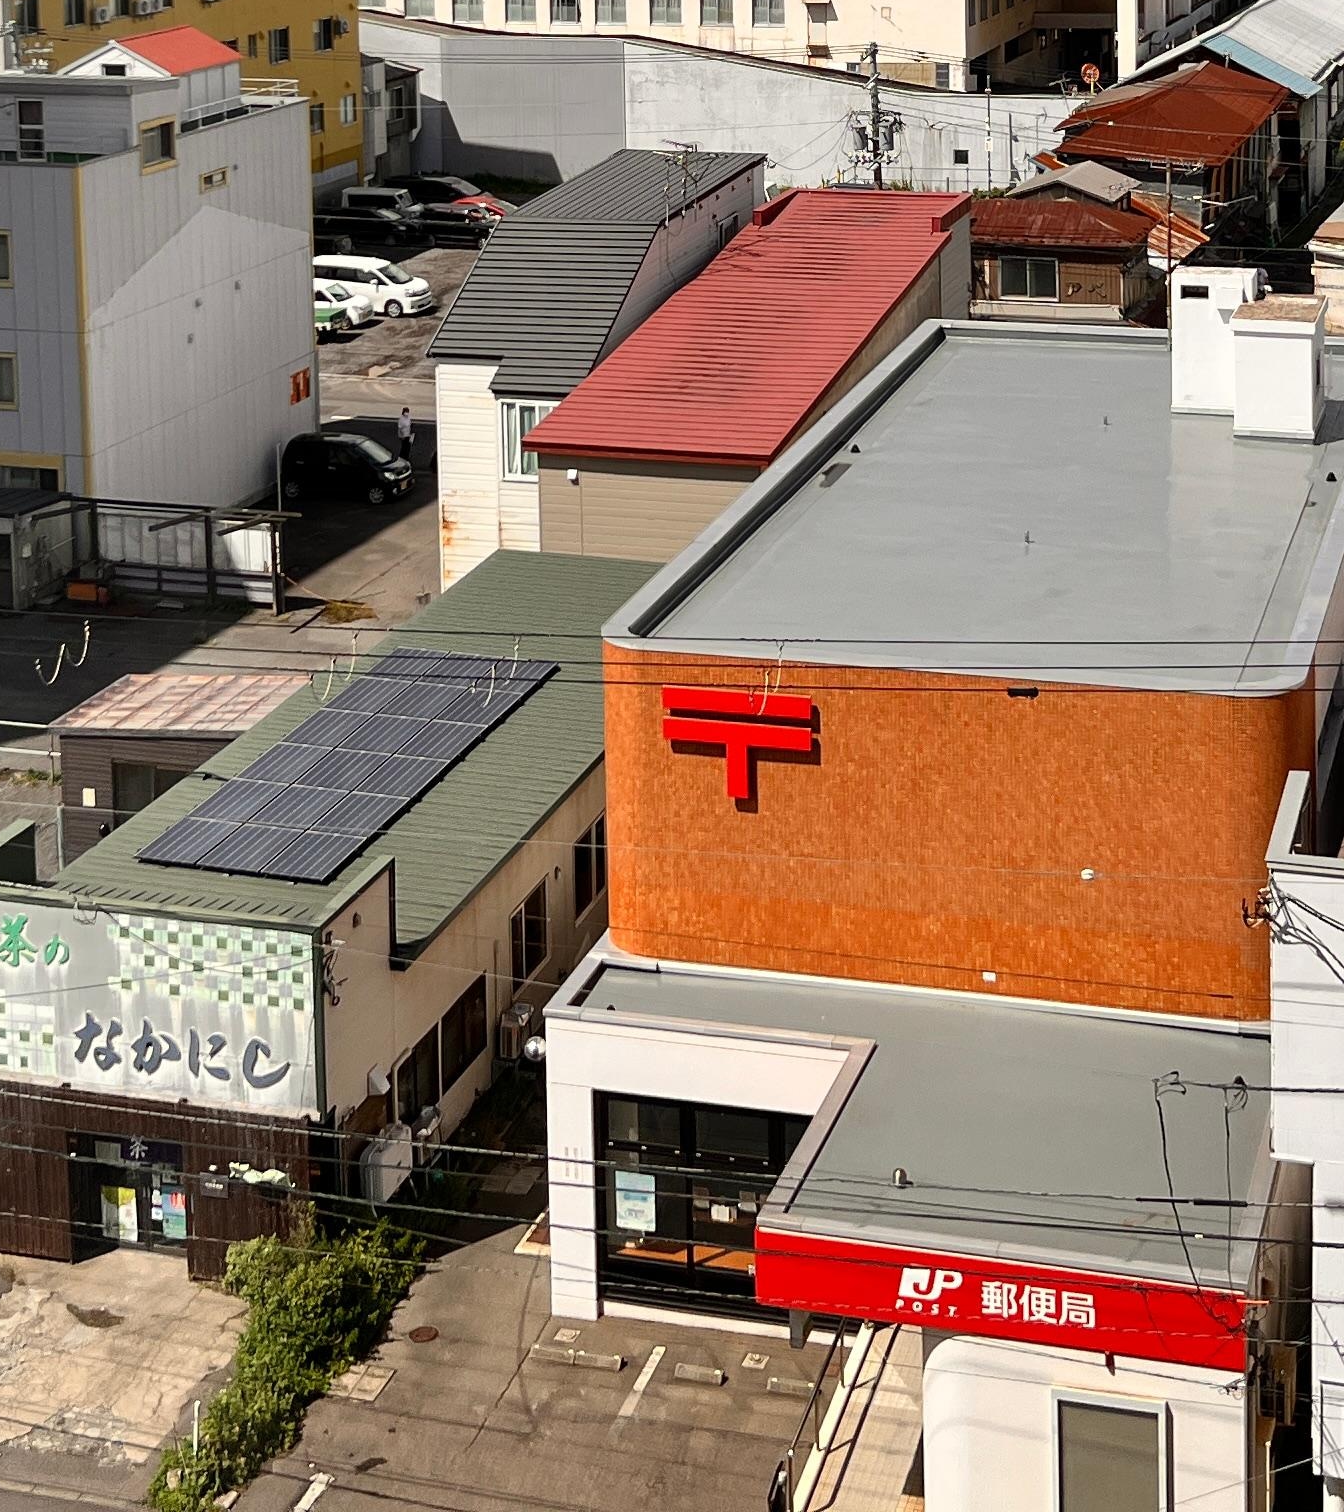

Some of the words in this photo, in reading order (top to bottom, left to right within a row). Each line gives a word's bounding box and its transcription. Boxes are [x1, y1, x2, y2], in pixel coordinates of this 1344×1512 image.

[74, 1010, 291, 1088] なかにし
[129, 1136, 148, 1159] 茶
[898, 1267, 963, 1300] JP
[895, 1299, 958, 1317] POST
[981, 1280, 1096, 1328] 郵便局
